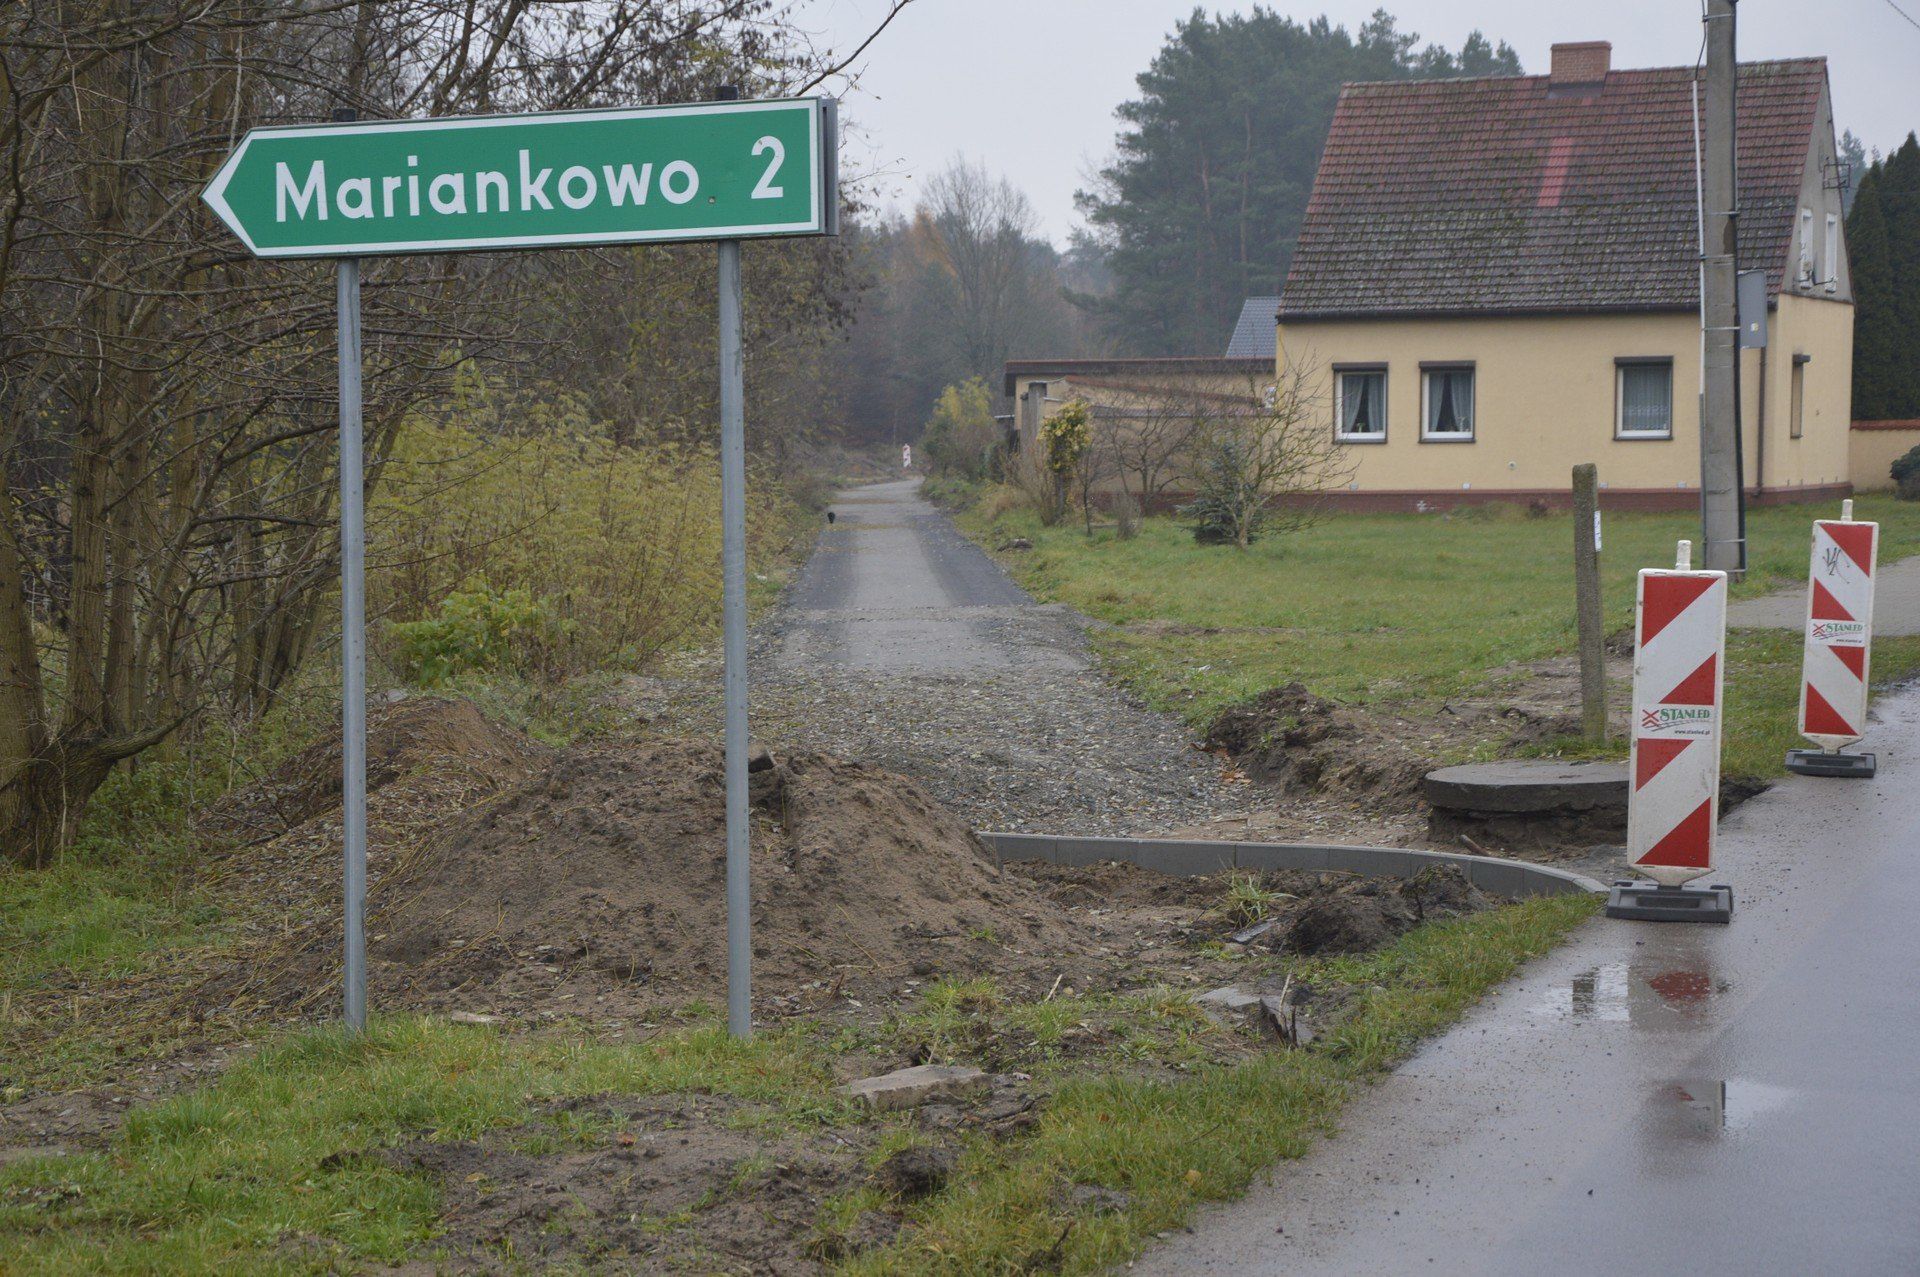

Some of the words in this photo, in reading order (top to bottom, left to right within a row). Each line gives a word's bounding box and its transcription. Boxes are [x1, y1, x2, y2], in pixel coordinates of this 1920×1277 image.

[275, 148, 700, 223] Mariankowo
[750, 135, 786, 200] 2
[1660, 708, 1710, 721] STANLED
